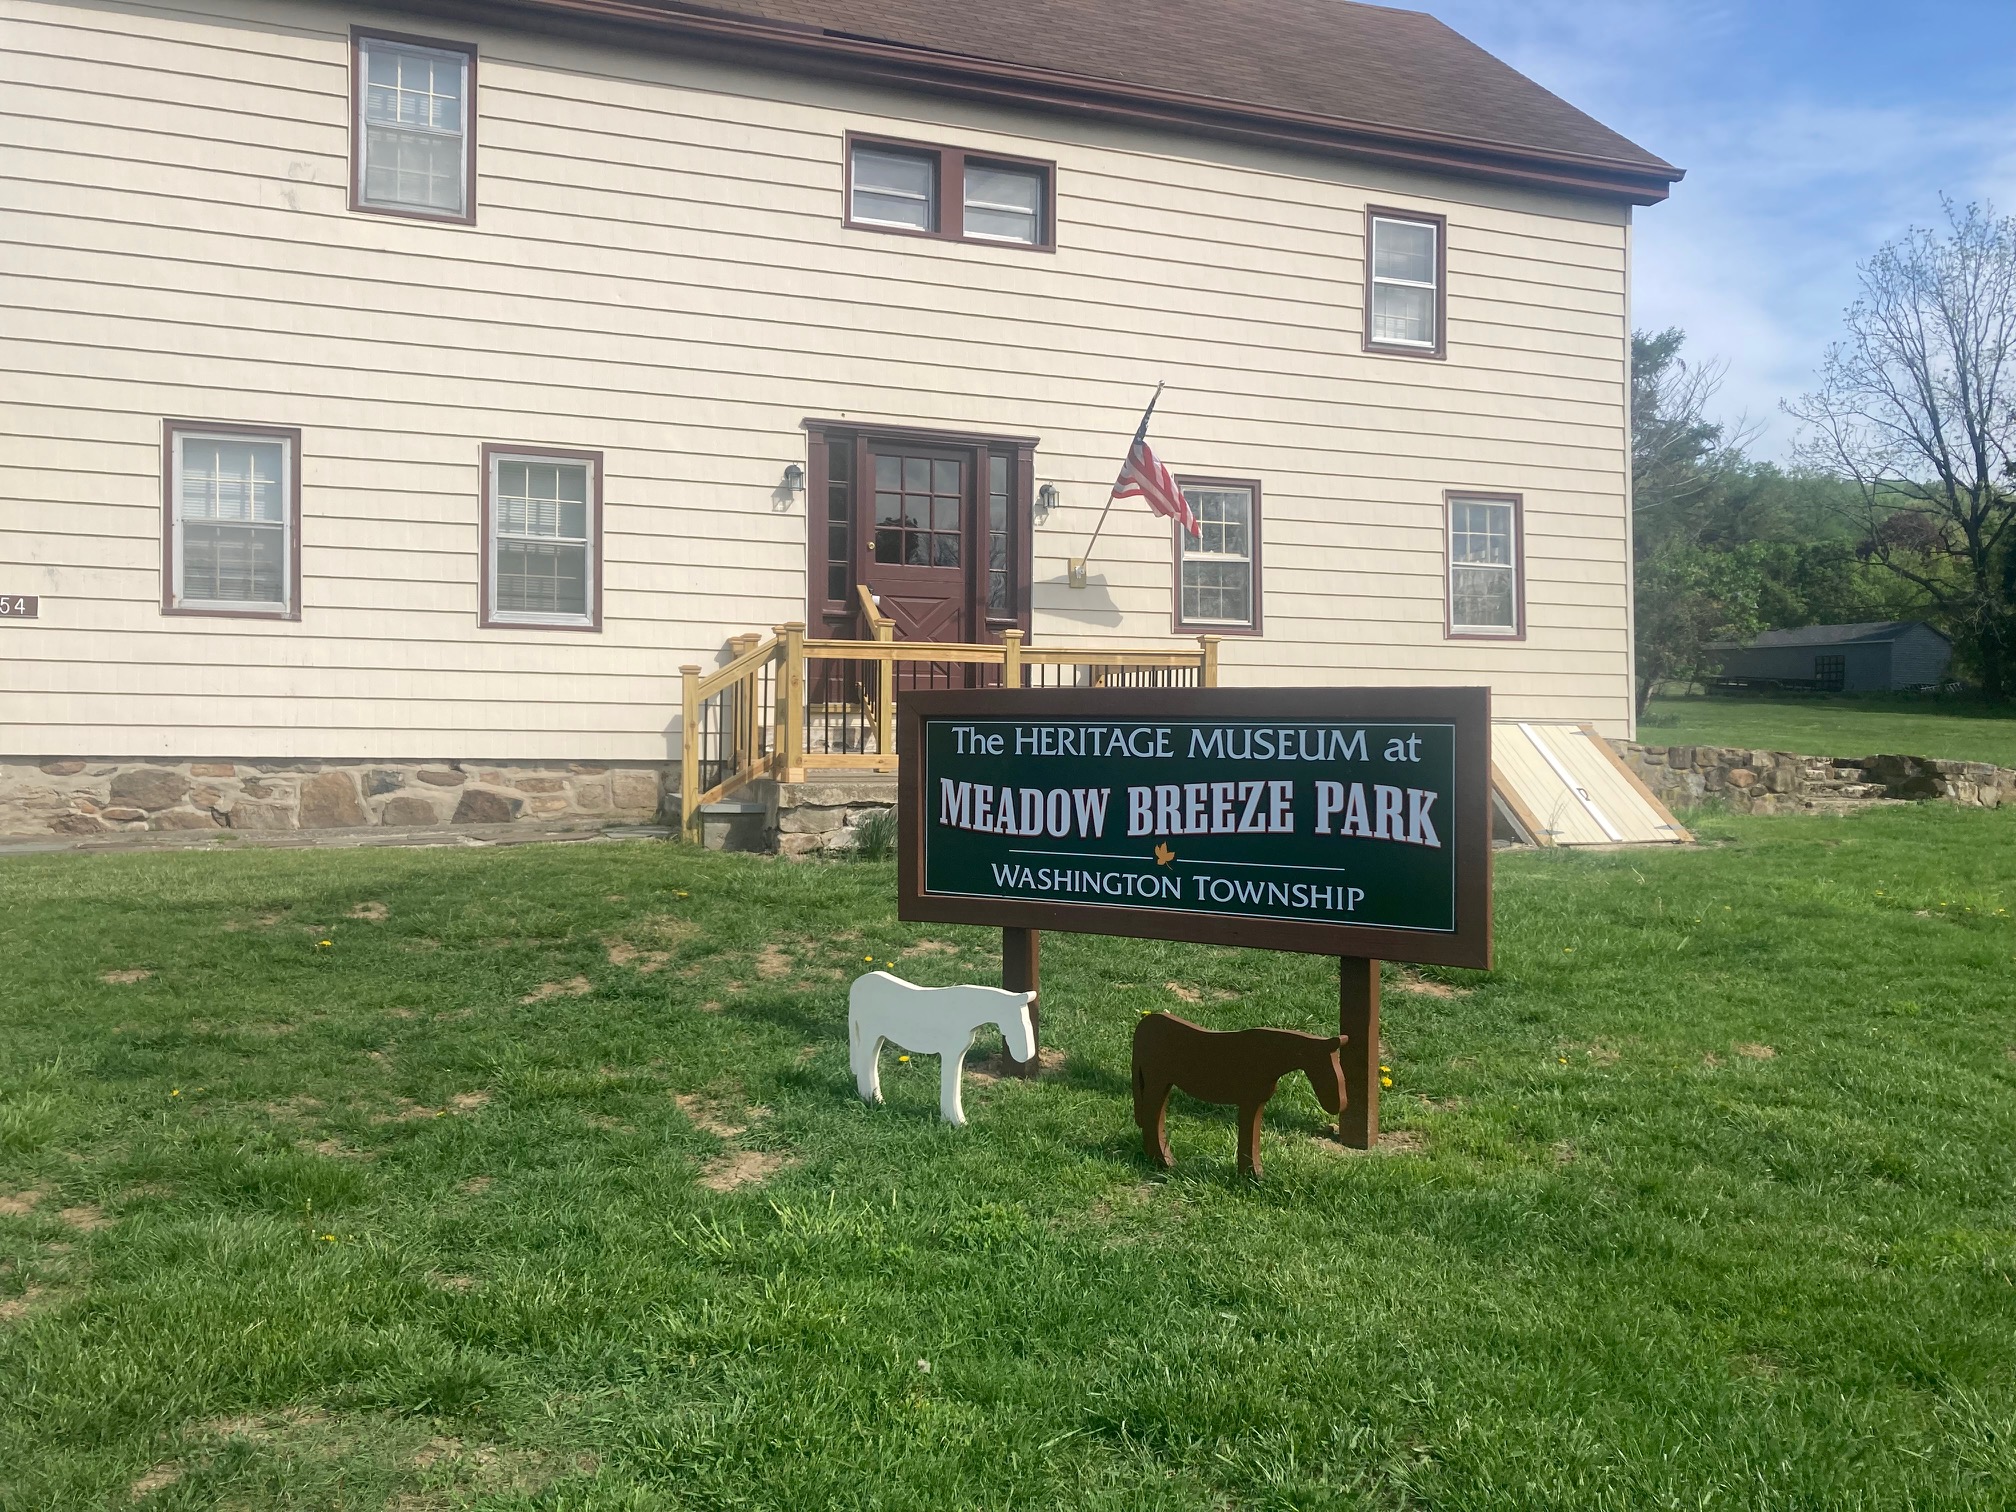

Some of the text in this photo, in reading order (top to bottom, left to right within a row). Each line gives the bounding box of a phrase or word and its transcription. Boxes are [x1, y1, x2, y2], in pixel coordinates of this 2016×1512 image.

[952, 727, 1422, 763] The HERITAGE MUSEUM at
[938, 777, 1442, 849] MEADOW BREEZE PARK
[991, 863, 1365, 911] WASHINGTON TOWNSHIP
